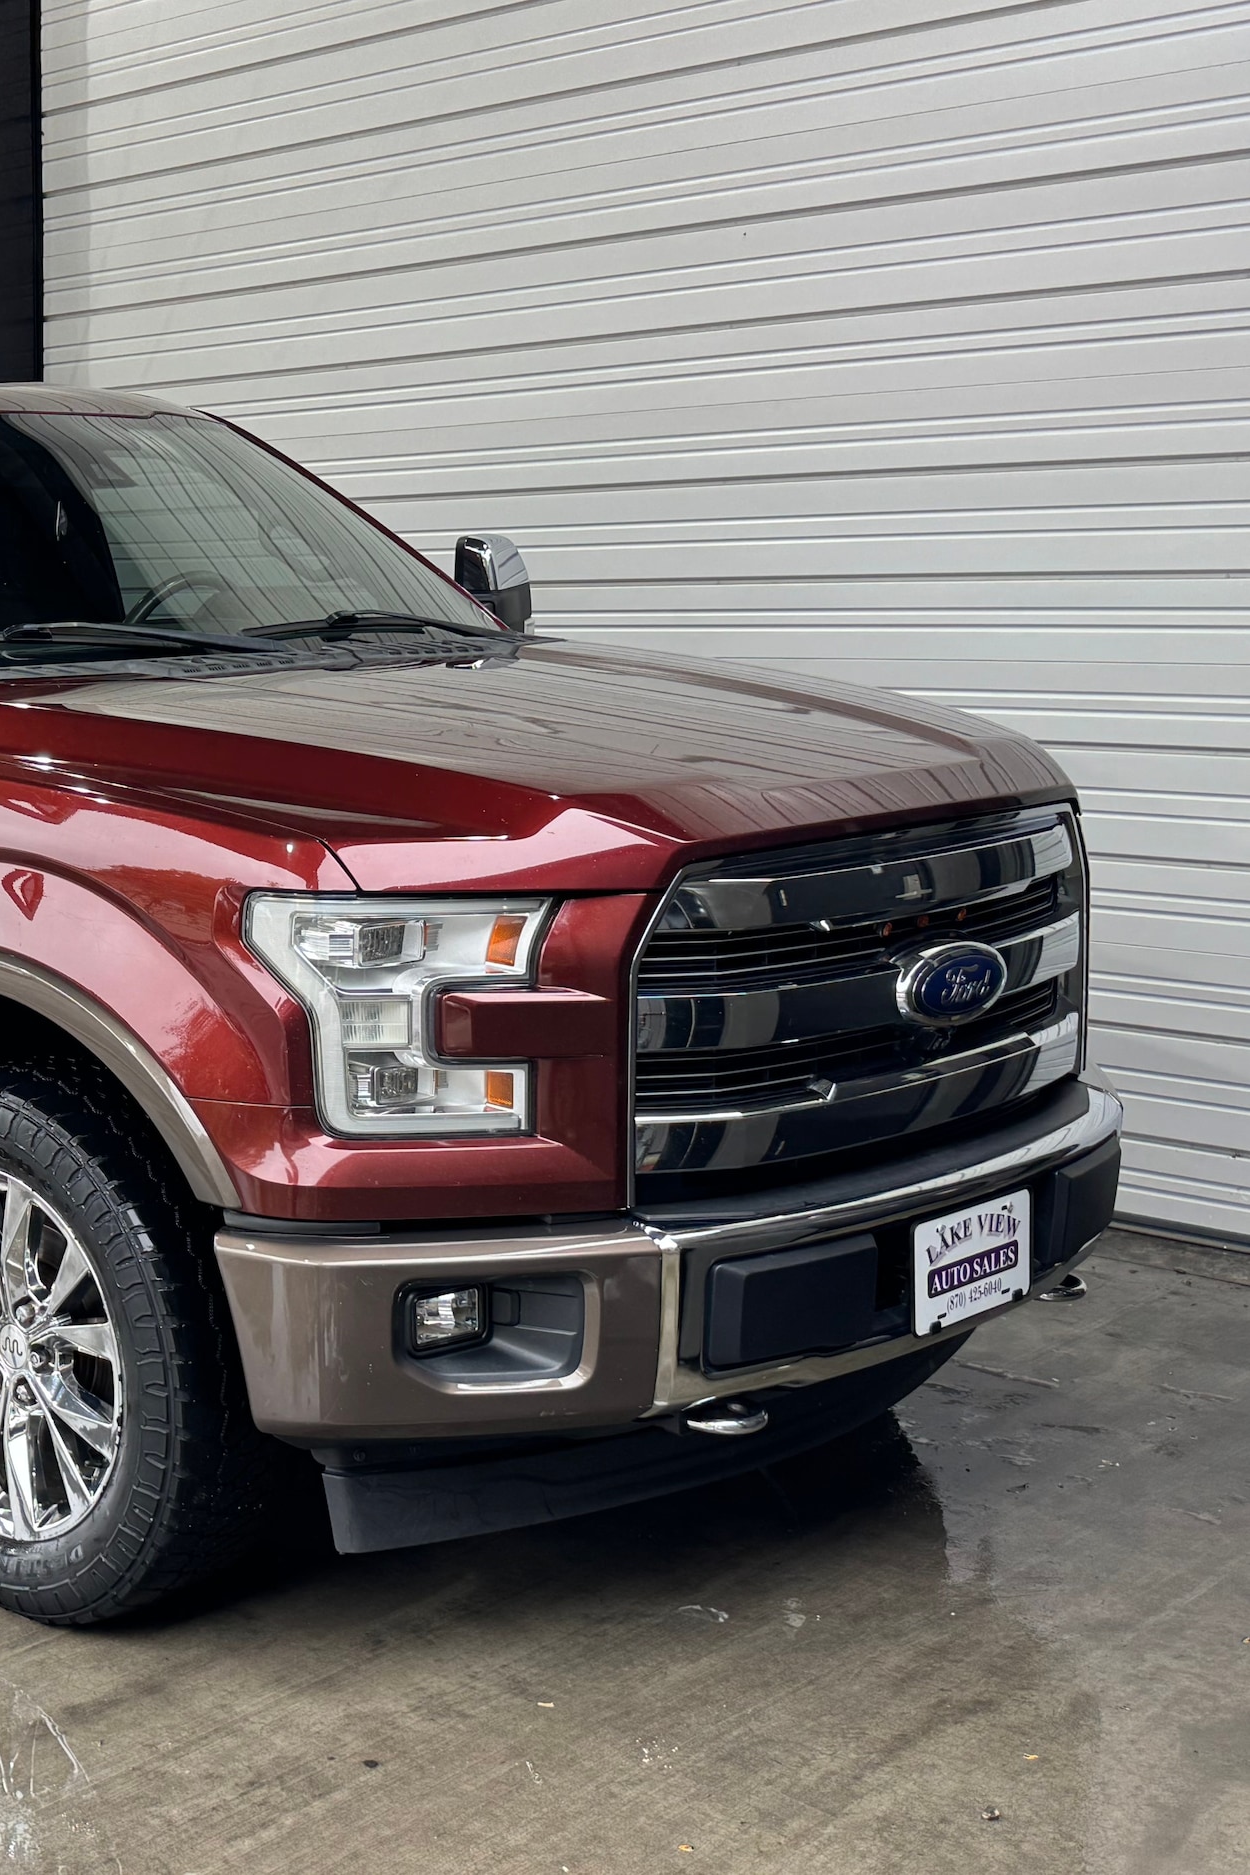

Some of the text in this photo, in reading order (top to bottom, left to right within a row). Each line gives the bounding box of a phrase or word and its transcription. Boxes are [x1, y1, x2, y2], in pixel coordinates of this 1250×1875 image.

[940, 963, 992, 1006] Ford
[925, 1213, 1021, 1266] LAKE VIEW
[931, 1246, 1016, 1294] AUTO SALES
[946, 1277, 1002, 1314] (870) 425-6040
